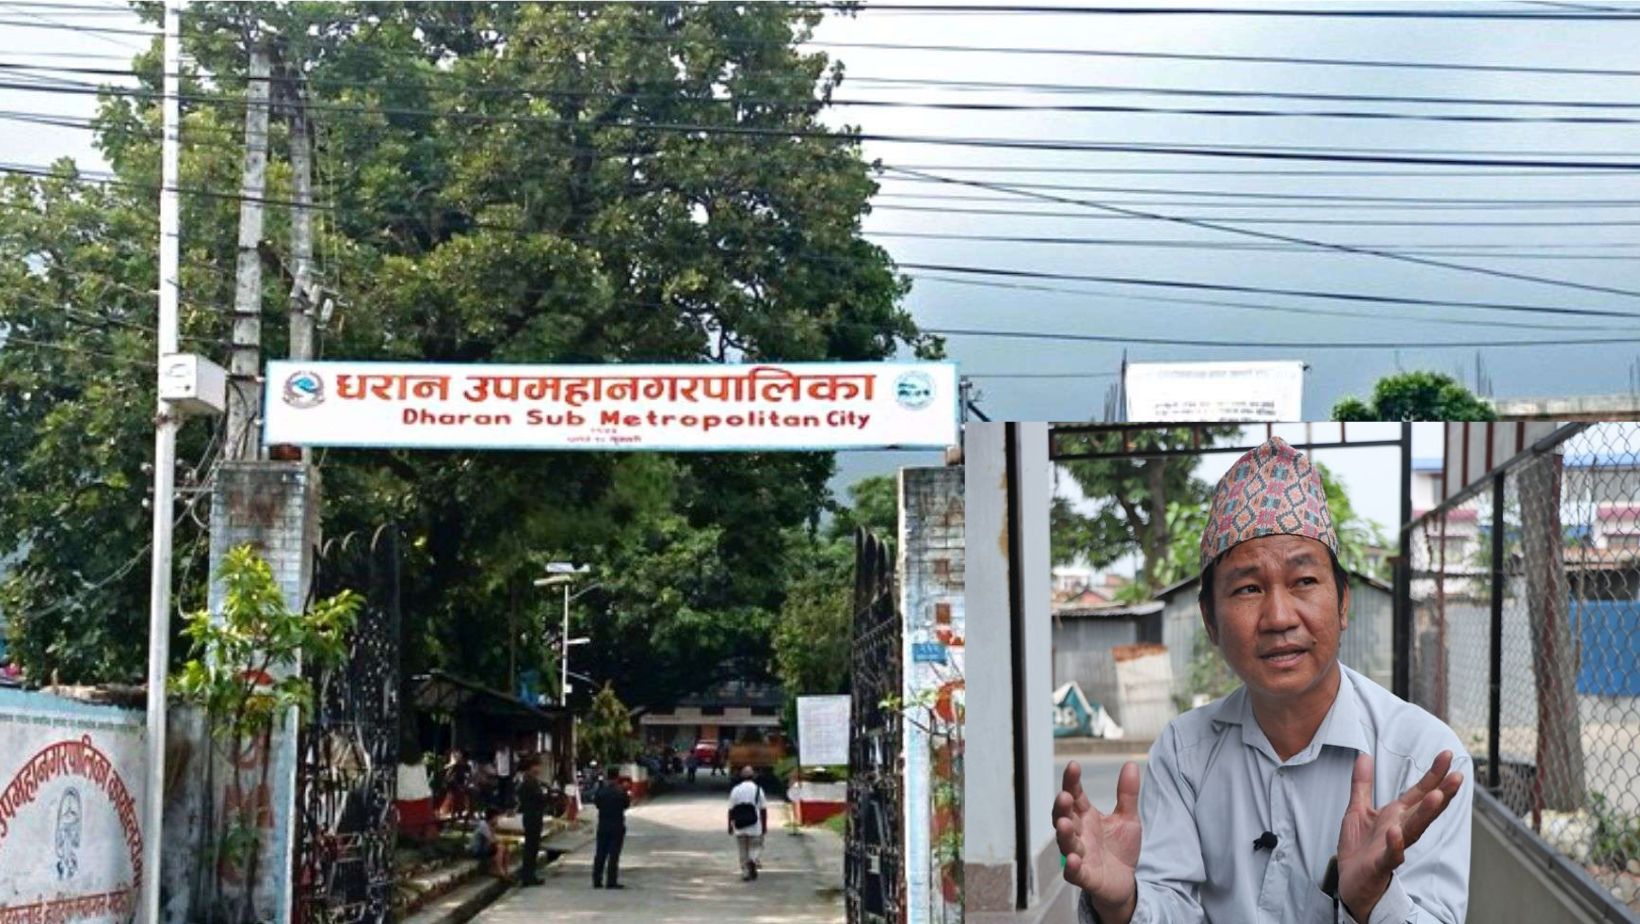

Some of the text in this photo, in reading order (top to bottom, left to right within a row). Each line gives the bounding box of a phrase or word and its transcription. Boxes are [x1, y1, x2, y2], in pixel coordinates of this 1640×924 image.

[336, 366, 875, 408] धरान उपमहानगरपालिका
[402, 407, 512, 426] Dharan
[526, 408, 586, 427] Sub
[600, 410, 820, 431] Metropolitan
[826, 410, 870, 430] City
